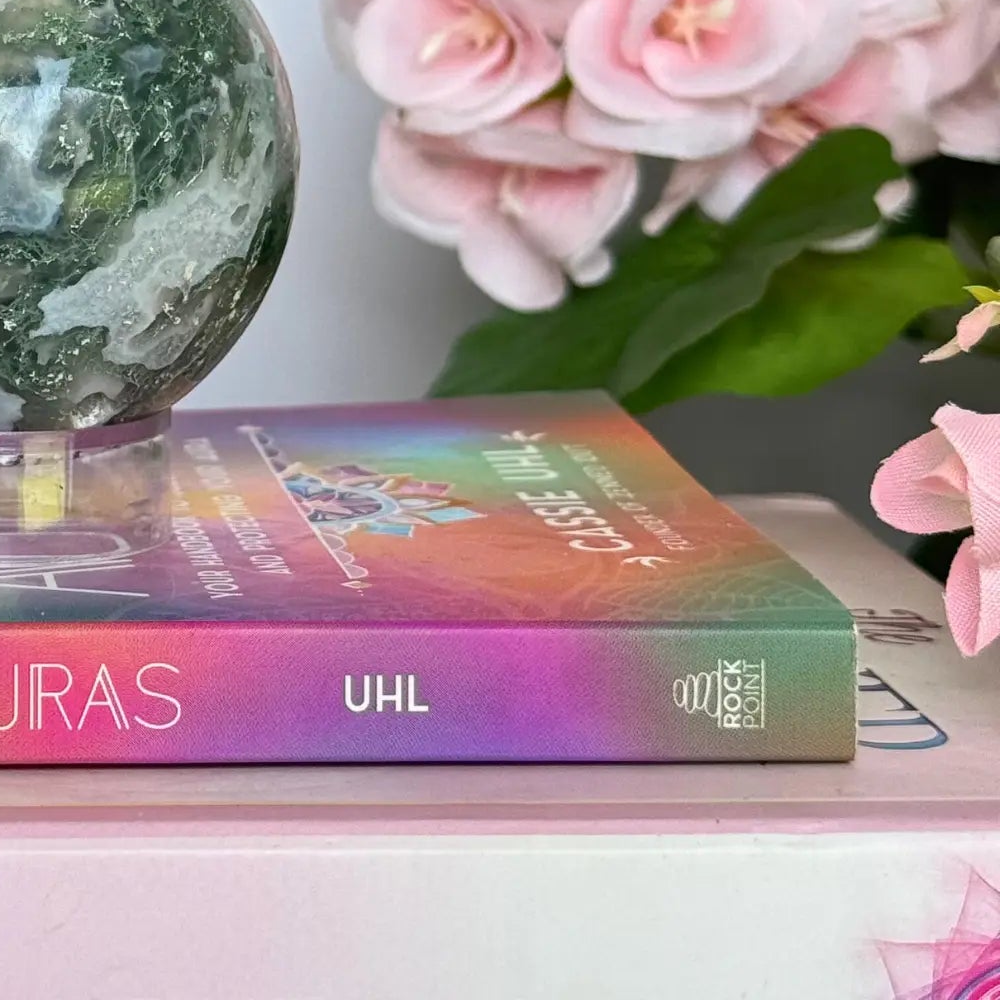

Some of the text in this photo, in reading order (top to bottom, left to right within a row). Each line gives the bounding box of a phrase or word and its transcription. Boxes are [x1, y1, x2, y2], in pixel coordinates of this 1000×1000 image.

[210, 494, 277, 552] PROTECTING
[481, 444, 635, 552] CASSIE UHL
[196, 570, 245, 600] YOUR
[248, 553, 294, 576] AND
[343, 674, 430, 713] UHL
[722, 659, 742, 728] ROCK
[742, 658, 761, 729] POINT
